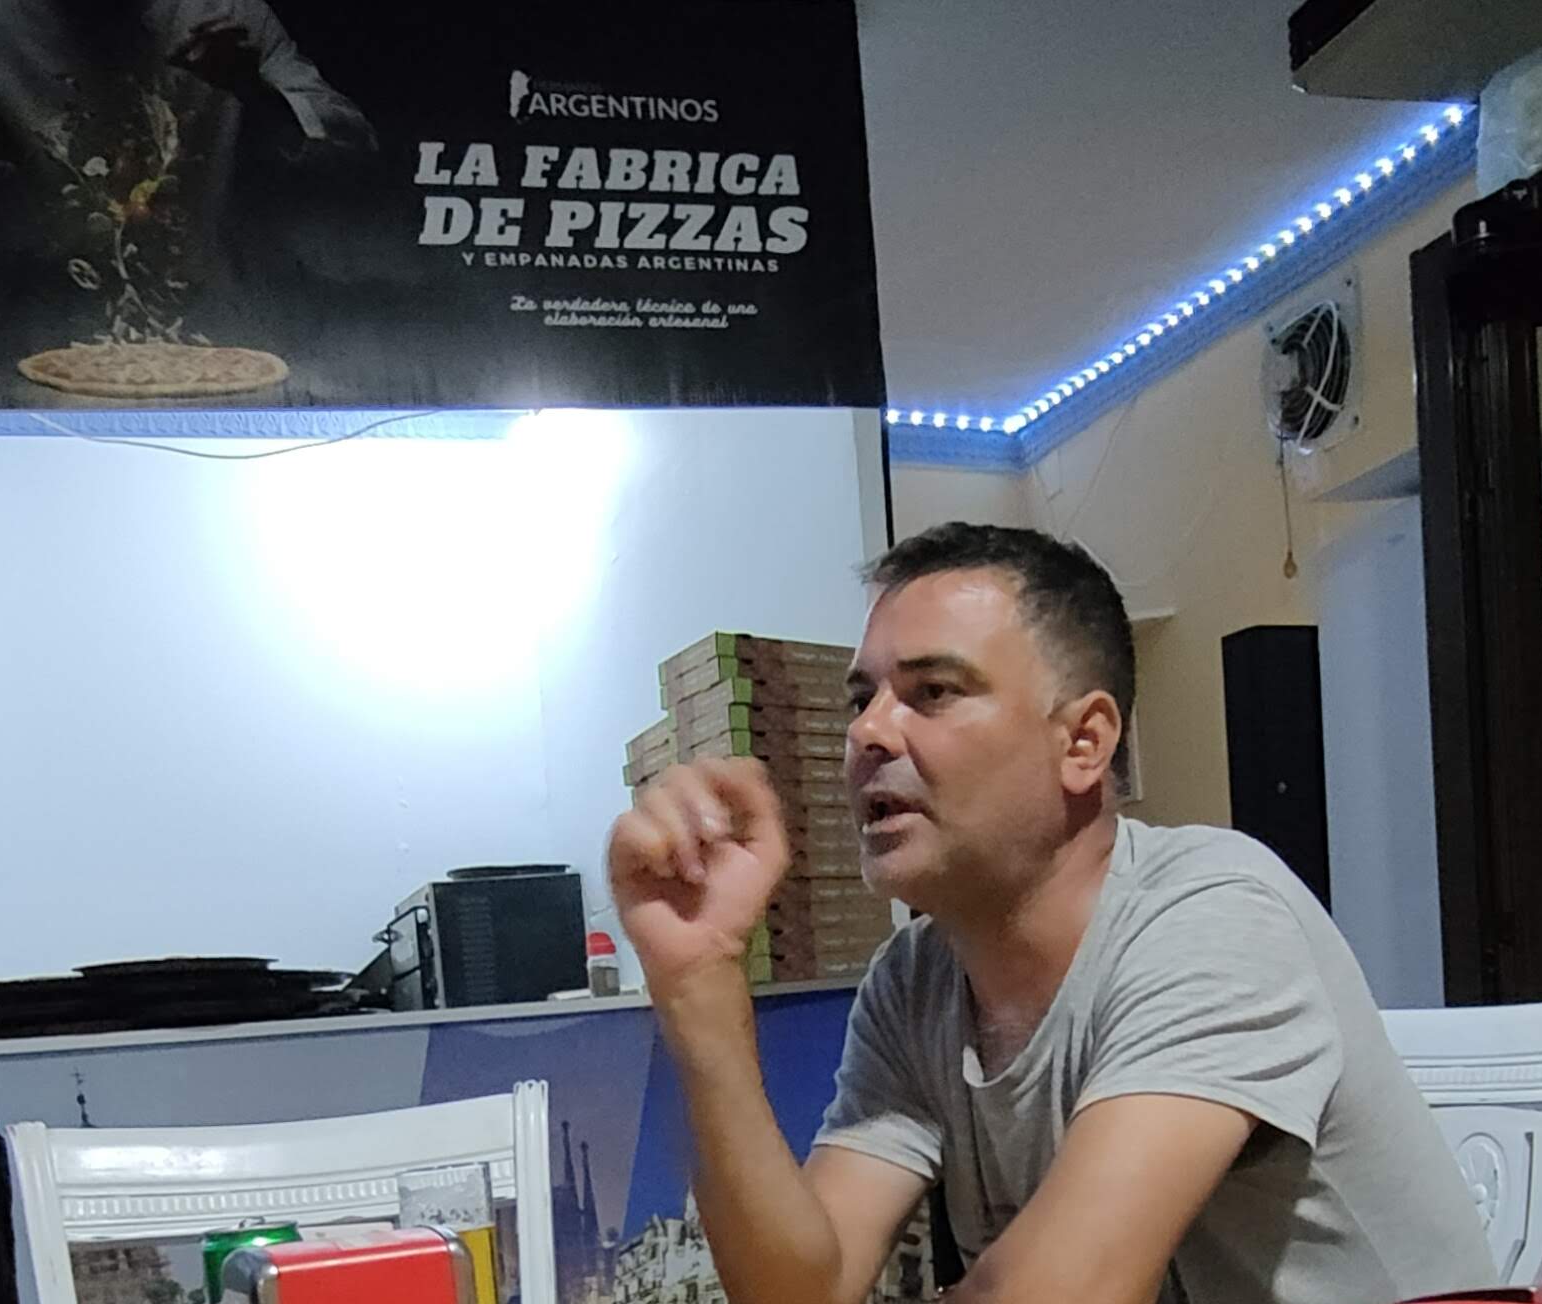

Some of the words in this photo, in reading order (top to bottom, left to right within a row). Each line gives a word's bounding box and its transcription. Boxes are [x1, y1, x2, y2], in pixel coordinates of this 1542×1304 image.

[528, 93, 719, 122] ARGENTINOS
[414, 142, 499, 186] LA
[520, 145, 801, 195] FABRICA
[418, 196, 525, 247] DE
[545, 200, 809, 255] PIZZAS
[462, 252, 476, 267] Y
[485, 252, 629, 270] EMPANADAS
[637, 255, 780, 273] ARGENTINAS
[701, 300, 723, 314] de
